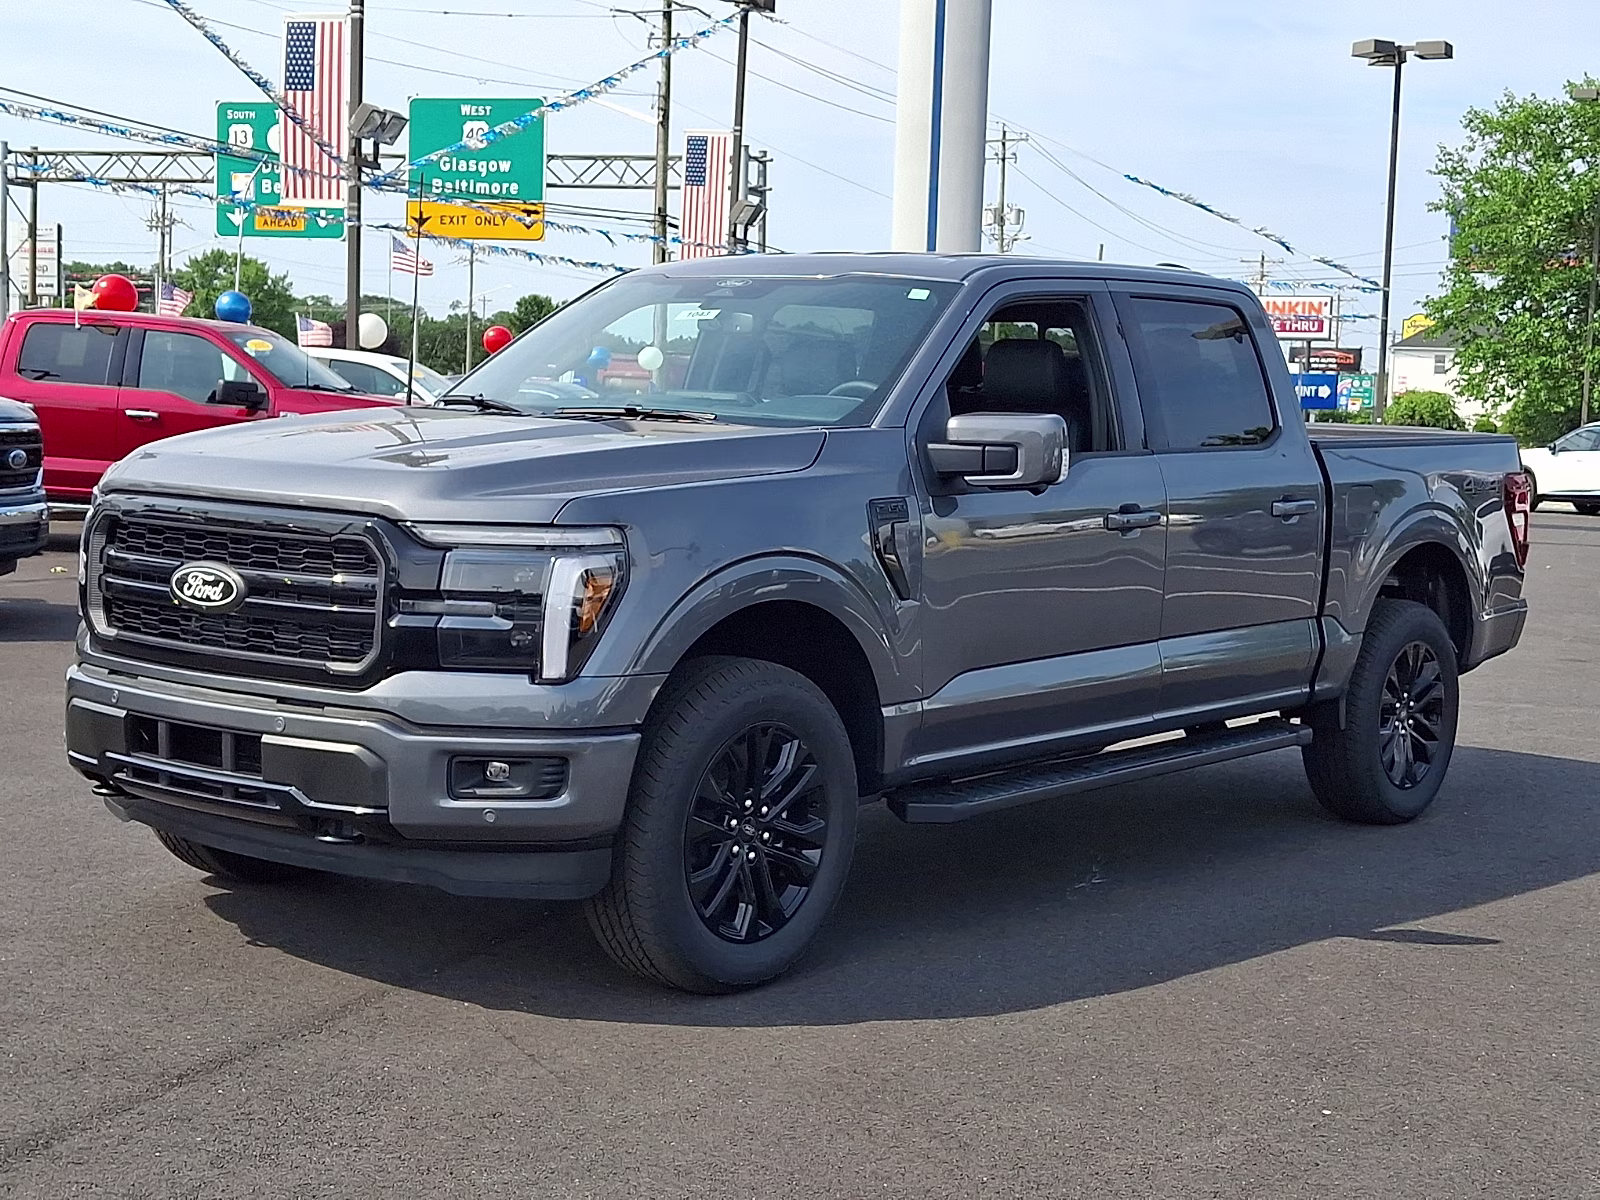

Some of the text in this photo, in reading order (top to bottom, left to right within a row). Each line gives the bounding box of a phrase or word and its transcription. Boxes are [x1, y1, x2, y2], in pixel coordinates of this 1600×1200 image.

[226, 110, 256, 120] SOUTH
[460, 104, 492, 116] WEST
[234, 130, 248, 145] 13
[439, 156, 511, 178] Glasgow
[431, 178, 519, 195] Baltimore
[262, 218, 299, 228] AHEAD
[440, 214, 508, 227] EXIT ONLY
[1283, 320, 1319, 332] THRU
[182, 571, 226, 601] Ford
